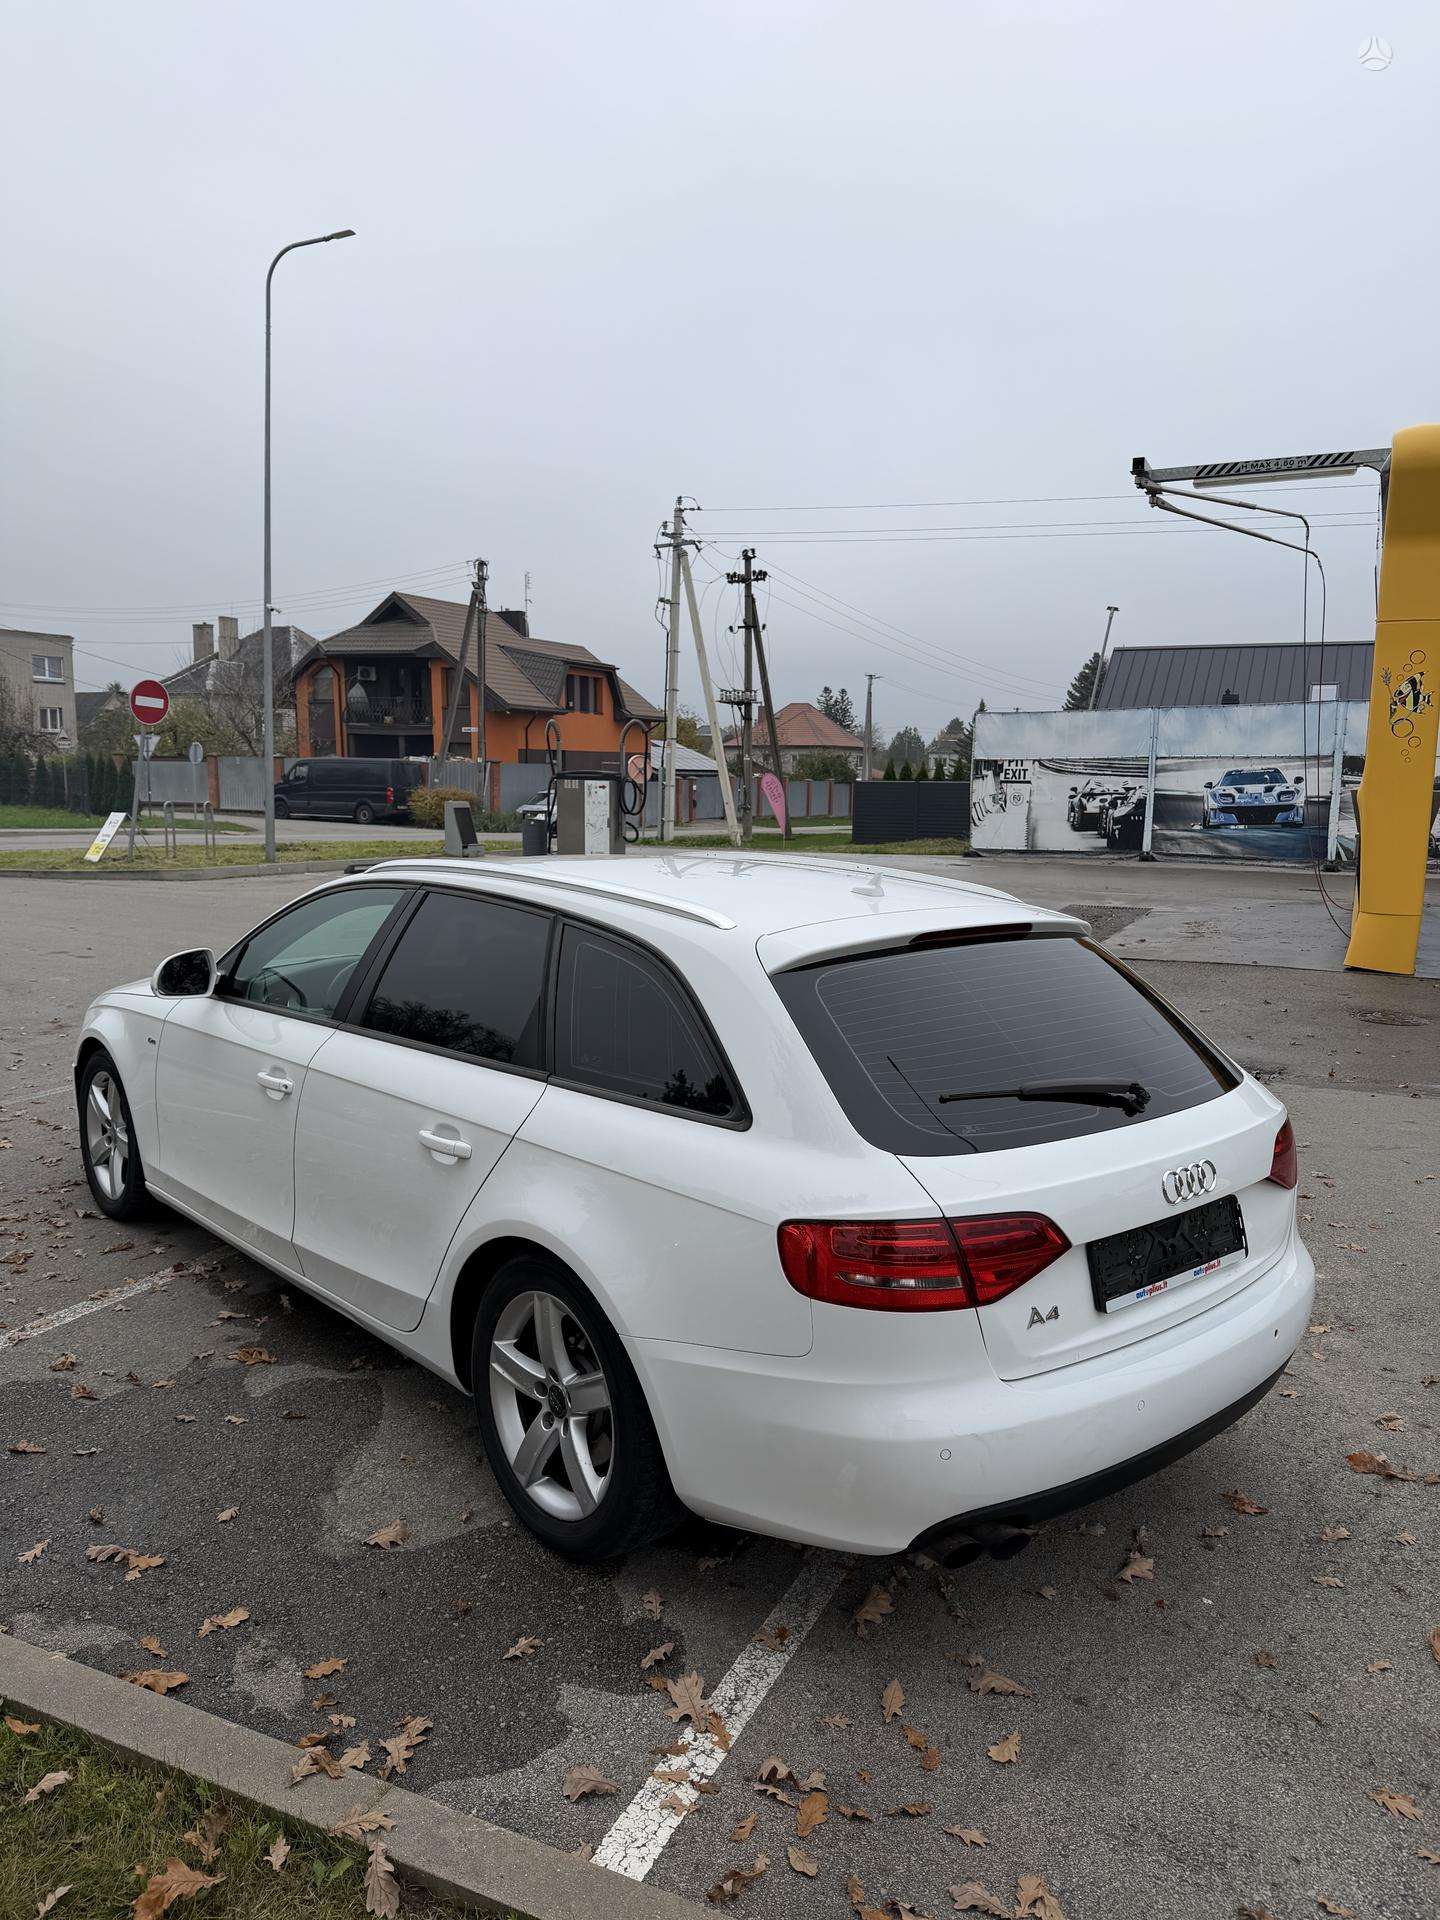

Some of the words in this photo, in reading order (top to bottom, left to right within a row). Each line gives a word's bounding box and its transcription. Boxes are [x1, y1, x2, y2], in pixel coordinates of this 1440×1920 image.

[1250, 461, 1272, 470] MAX
[1004, 768, 1029, 780] EXIT
[1135, 1280, 1169, 1299] autoplius.lt
[1026, 1305, 1061, 1330] A4
